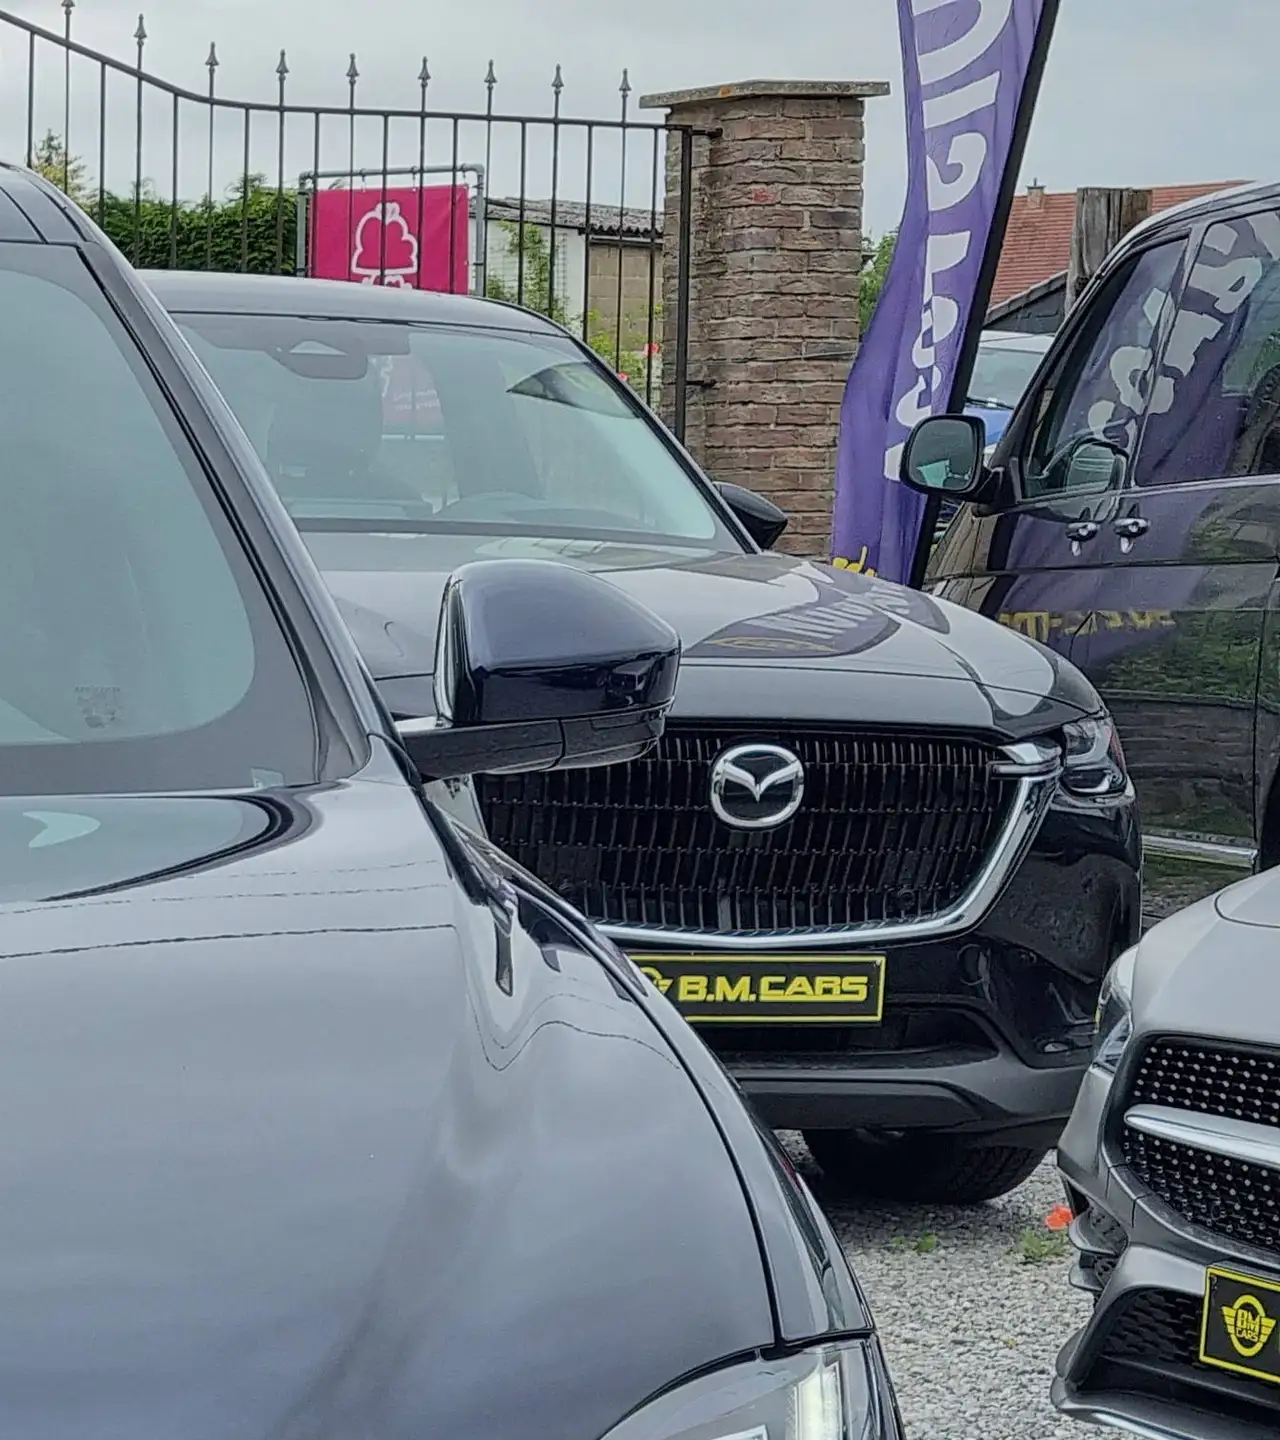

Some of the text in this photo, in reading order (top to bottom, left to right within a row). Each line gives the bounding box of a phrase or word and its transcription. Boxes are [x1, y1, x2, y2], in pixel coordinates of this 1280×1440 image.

[759, 975, 869, 1002] CARS
[1236, 1308, 1261, 1332] BM
[1235, 1327, 1260, 1343] CARS
